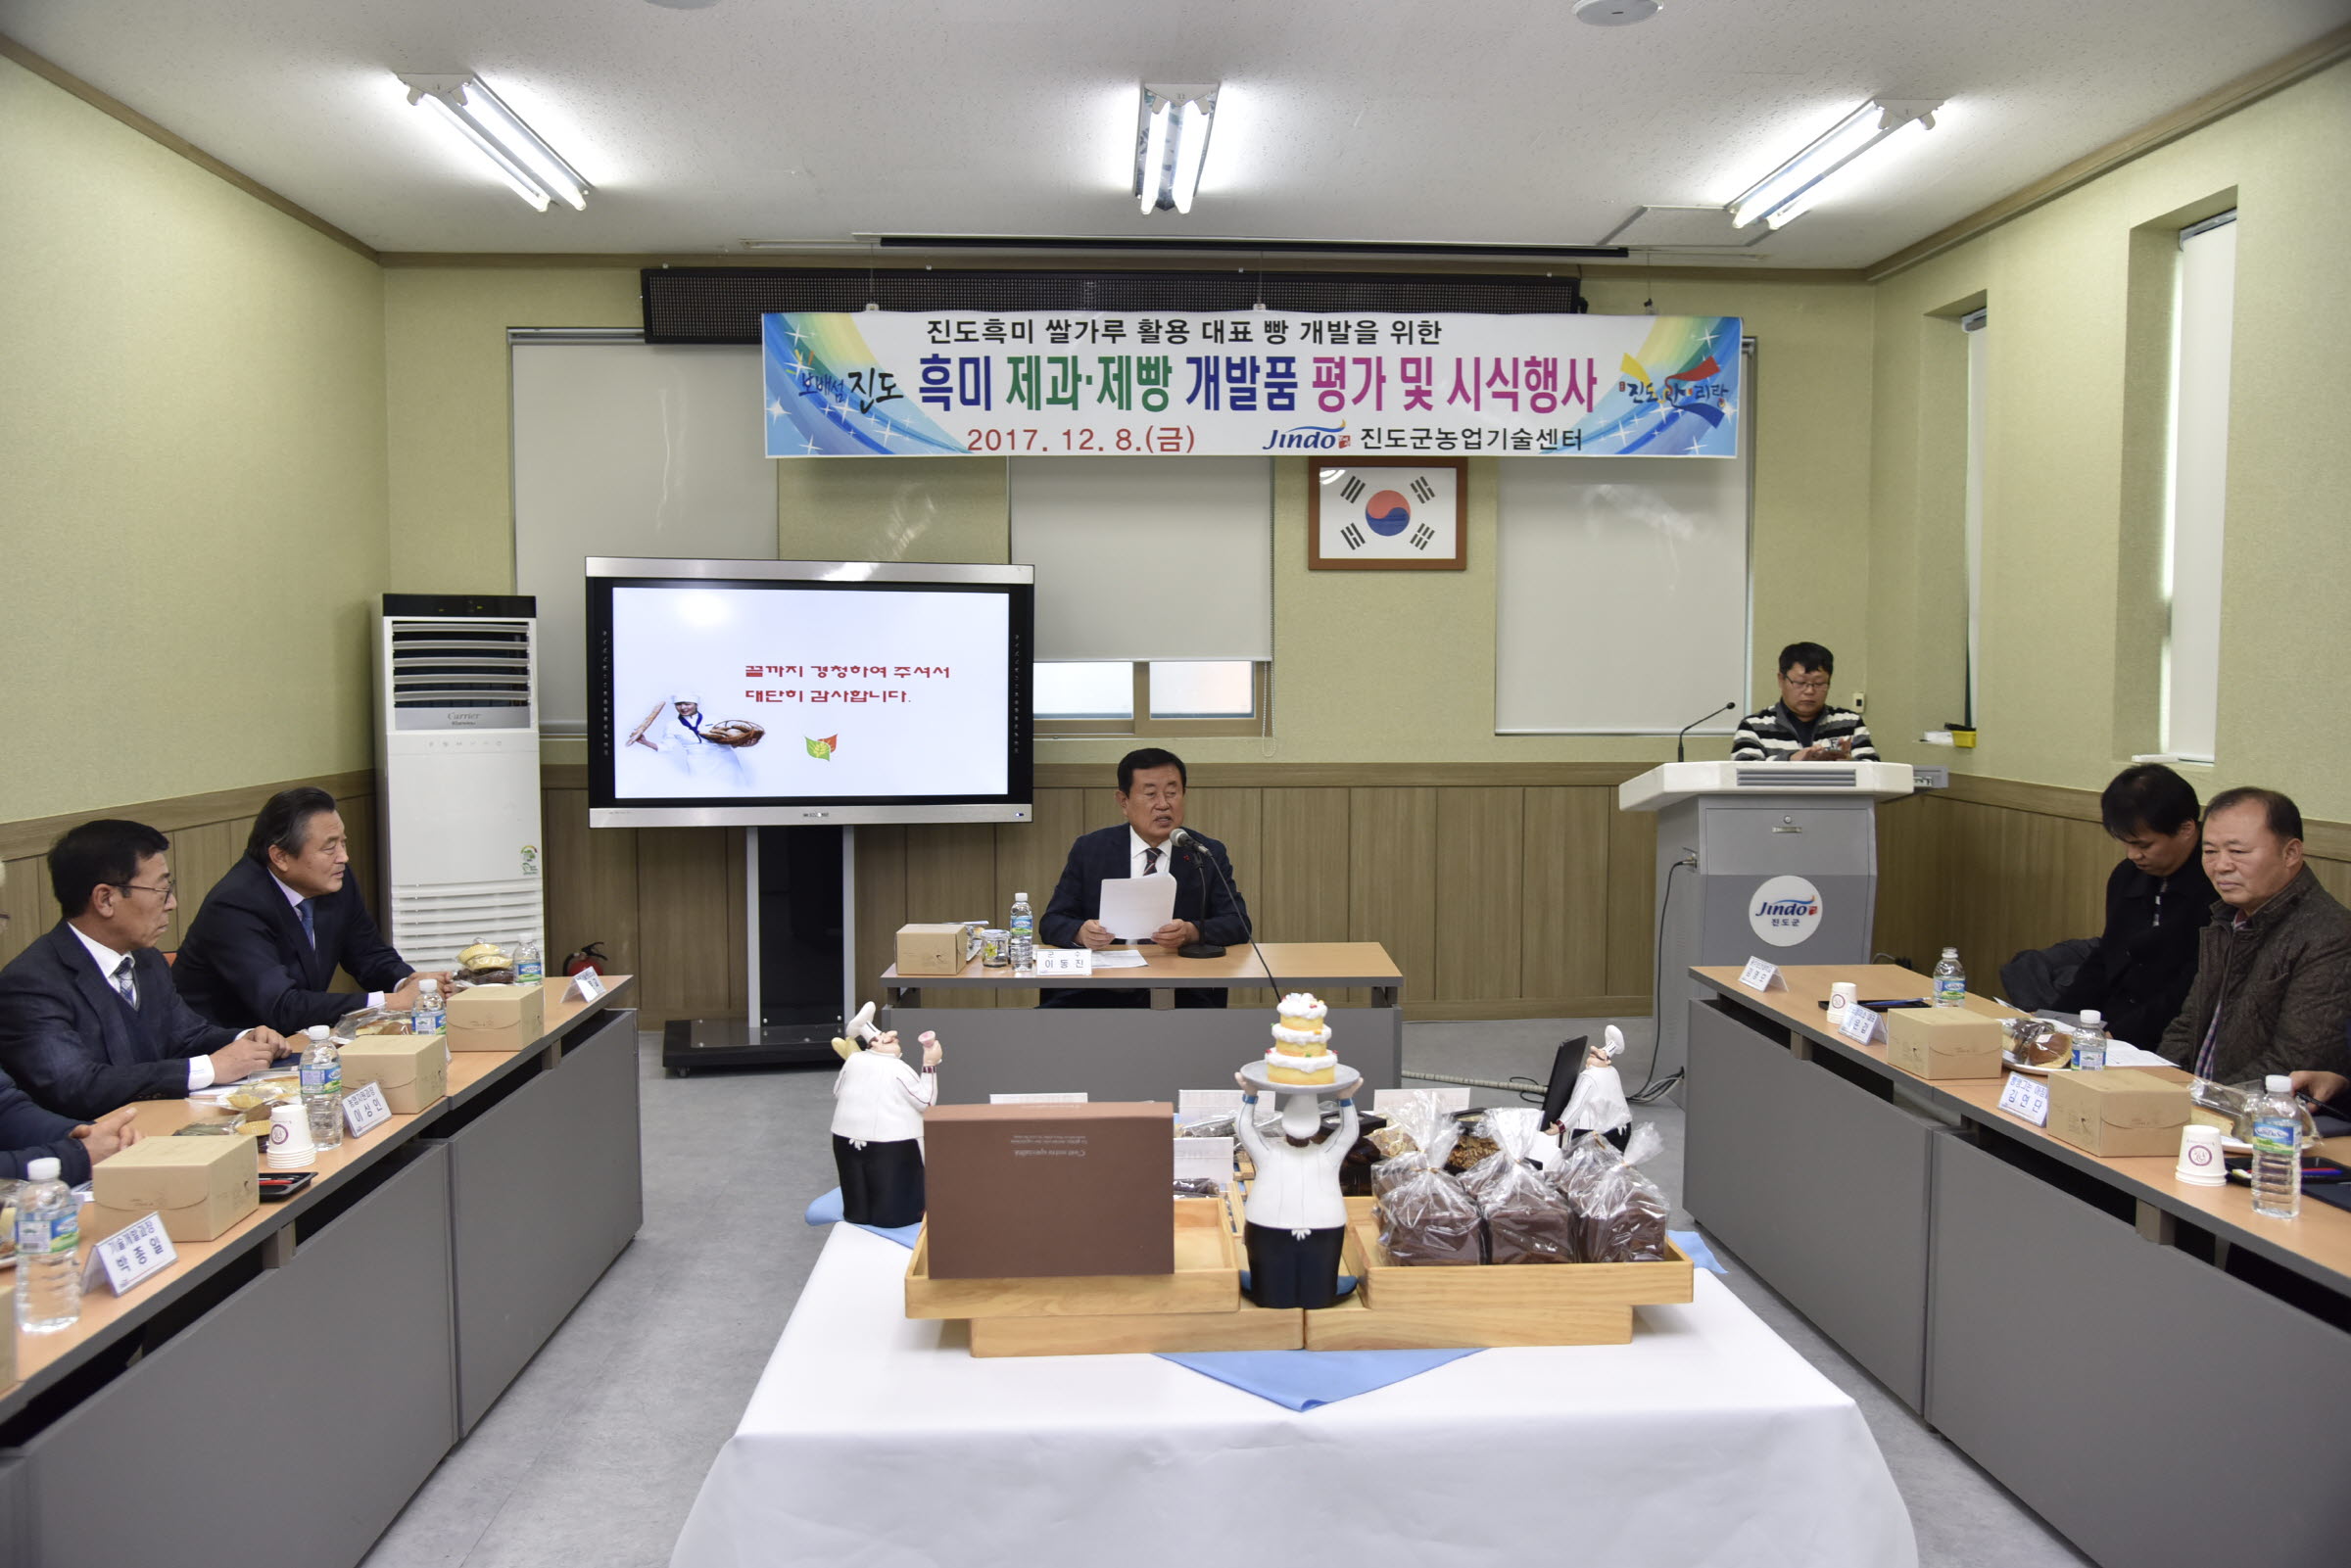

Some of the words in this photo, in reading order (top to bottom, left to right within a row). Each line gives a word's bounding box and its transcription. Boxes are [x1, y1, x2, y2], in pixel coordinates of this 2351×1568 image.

[927, 318, 1033, 344] 진도흑미
[1045, 318, 1127, 344] 쌀가루
[1136, 319, 1190, 345] 활용
[1202, 319, 1254, 345] 대표
[1264, 320, 1289, 345] 빵
[1300, 319, 1379, 345] 개발을
[1390, 319, 1442, 345] 위한
[847, 367, 904, 414] 진도
[918, 354, 991, 411] 흑미
[1006, 355, 1173, 412] 제과·제빵
[1185, 355, 1298, 412] 개발품
[1312, 356, 1386, 412] 평가
[1400, 356, 1433, 411] 및
[1447, 356, 1598, 413] 시식행사
[967, 429, 1048, 452] 2017.
[1062, 429, 1104, 452] 12.
[1116, 425, 1195, 453] 8.(금)
[1262, 429, 1336, 450] Jindo
[1361, 428, 1583, 453] 진도군농업기술센터
[810, 665, 887, 679] 경청하여
[893, 666, 950, 679] 주셔서
[744, 689, 803, 703] 대단히
[810, 689, 911, 703] 감사합니다.
[1755, 901, 1807, 917] Jindo
